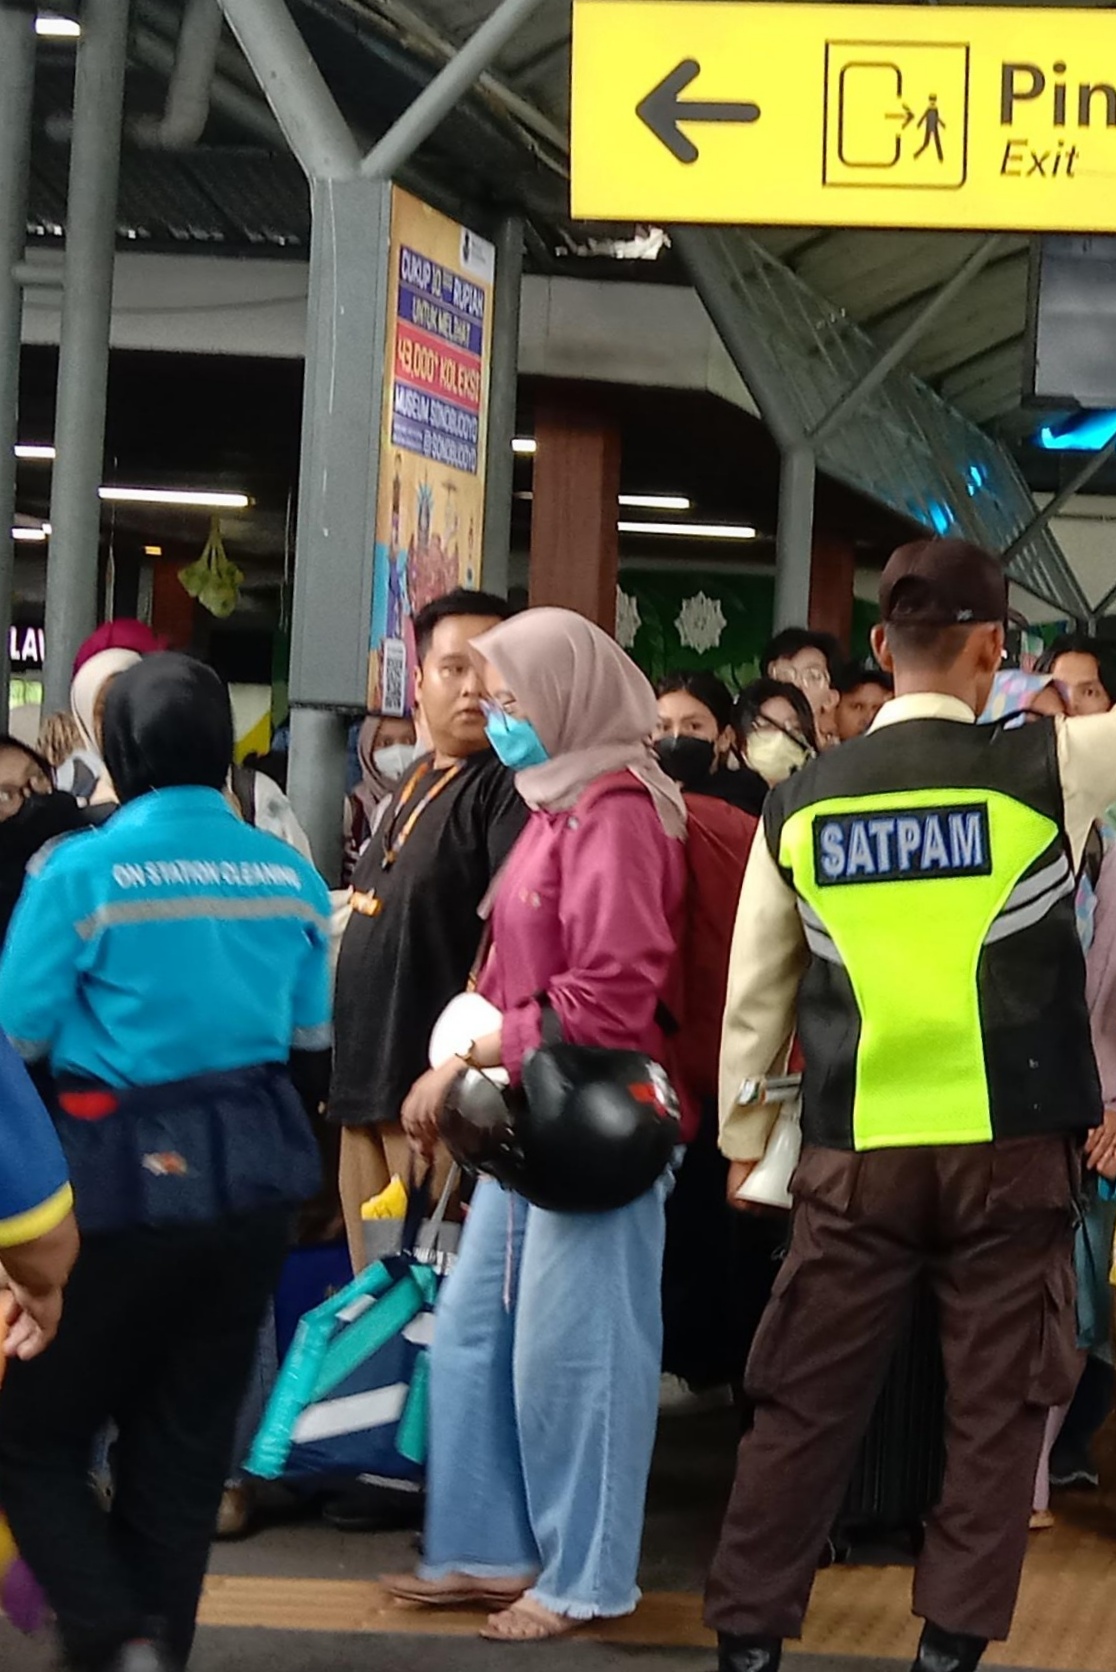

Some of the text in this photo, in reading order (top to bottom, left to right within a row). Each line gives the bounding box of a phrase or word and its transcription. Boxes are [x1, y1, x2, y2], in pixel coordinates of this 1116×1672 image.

[1000, 139, 1079, 178] Exit
[440, 357, 480, 403] KOLEKSI
[395, 384, 430, 424] MUSEUM
[820, 811, 984, 879] SATPAM
[113, 863, 146, 889] ON
